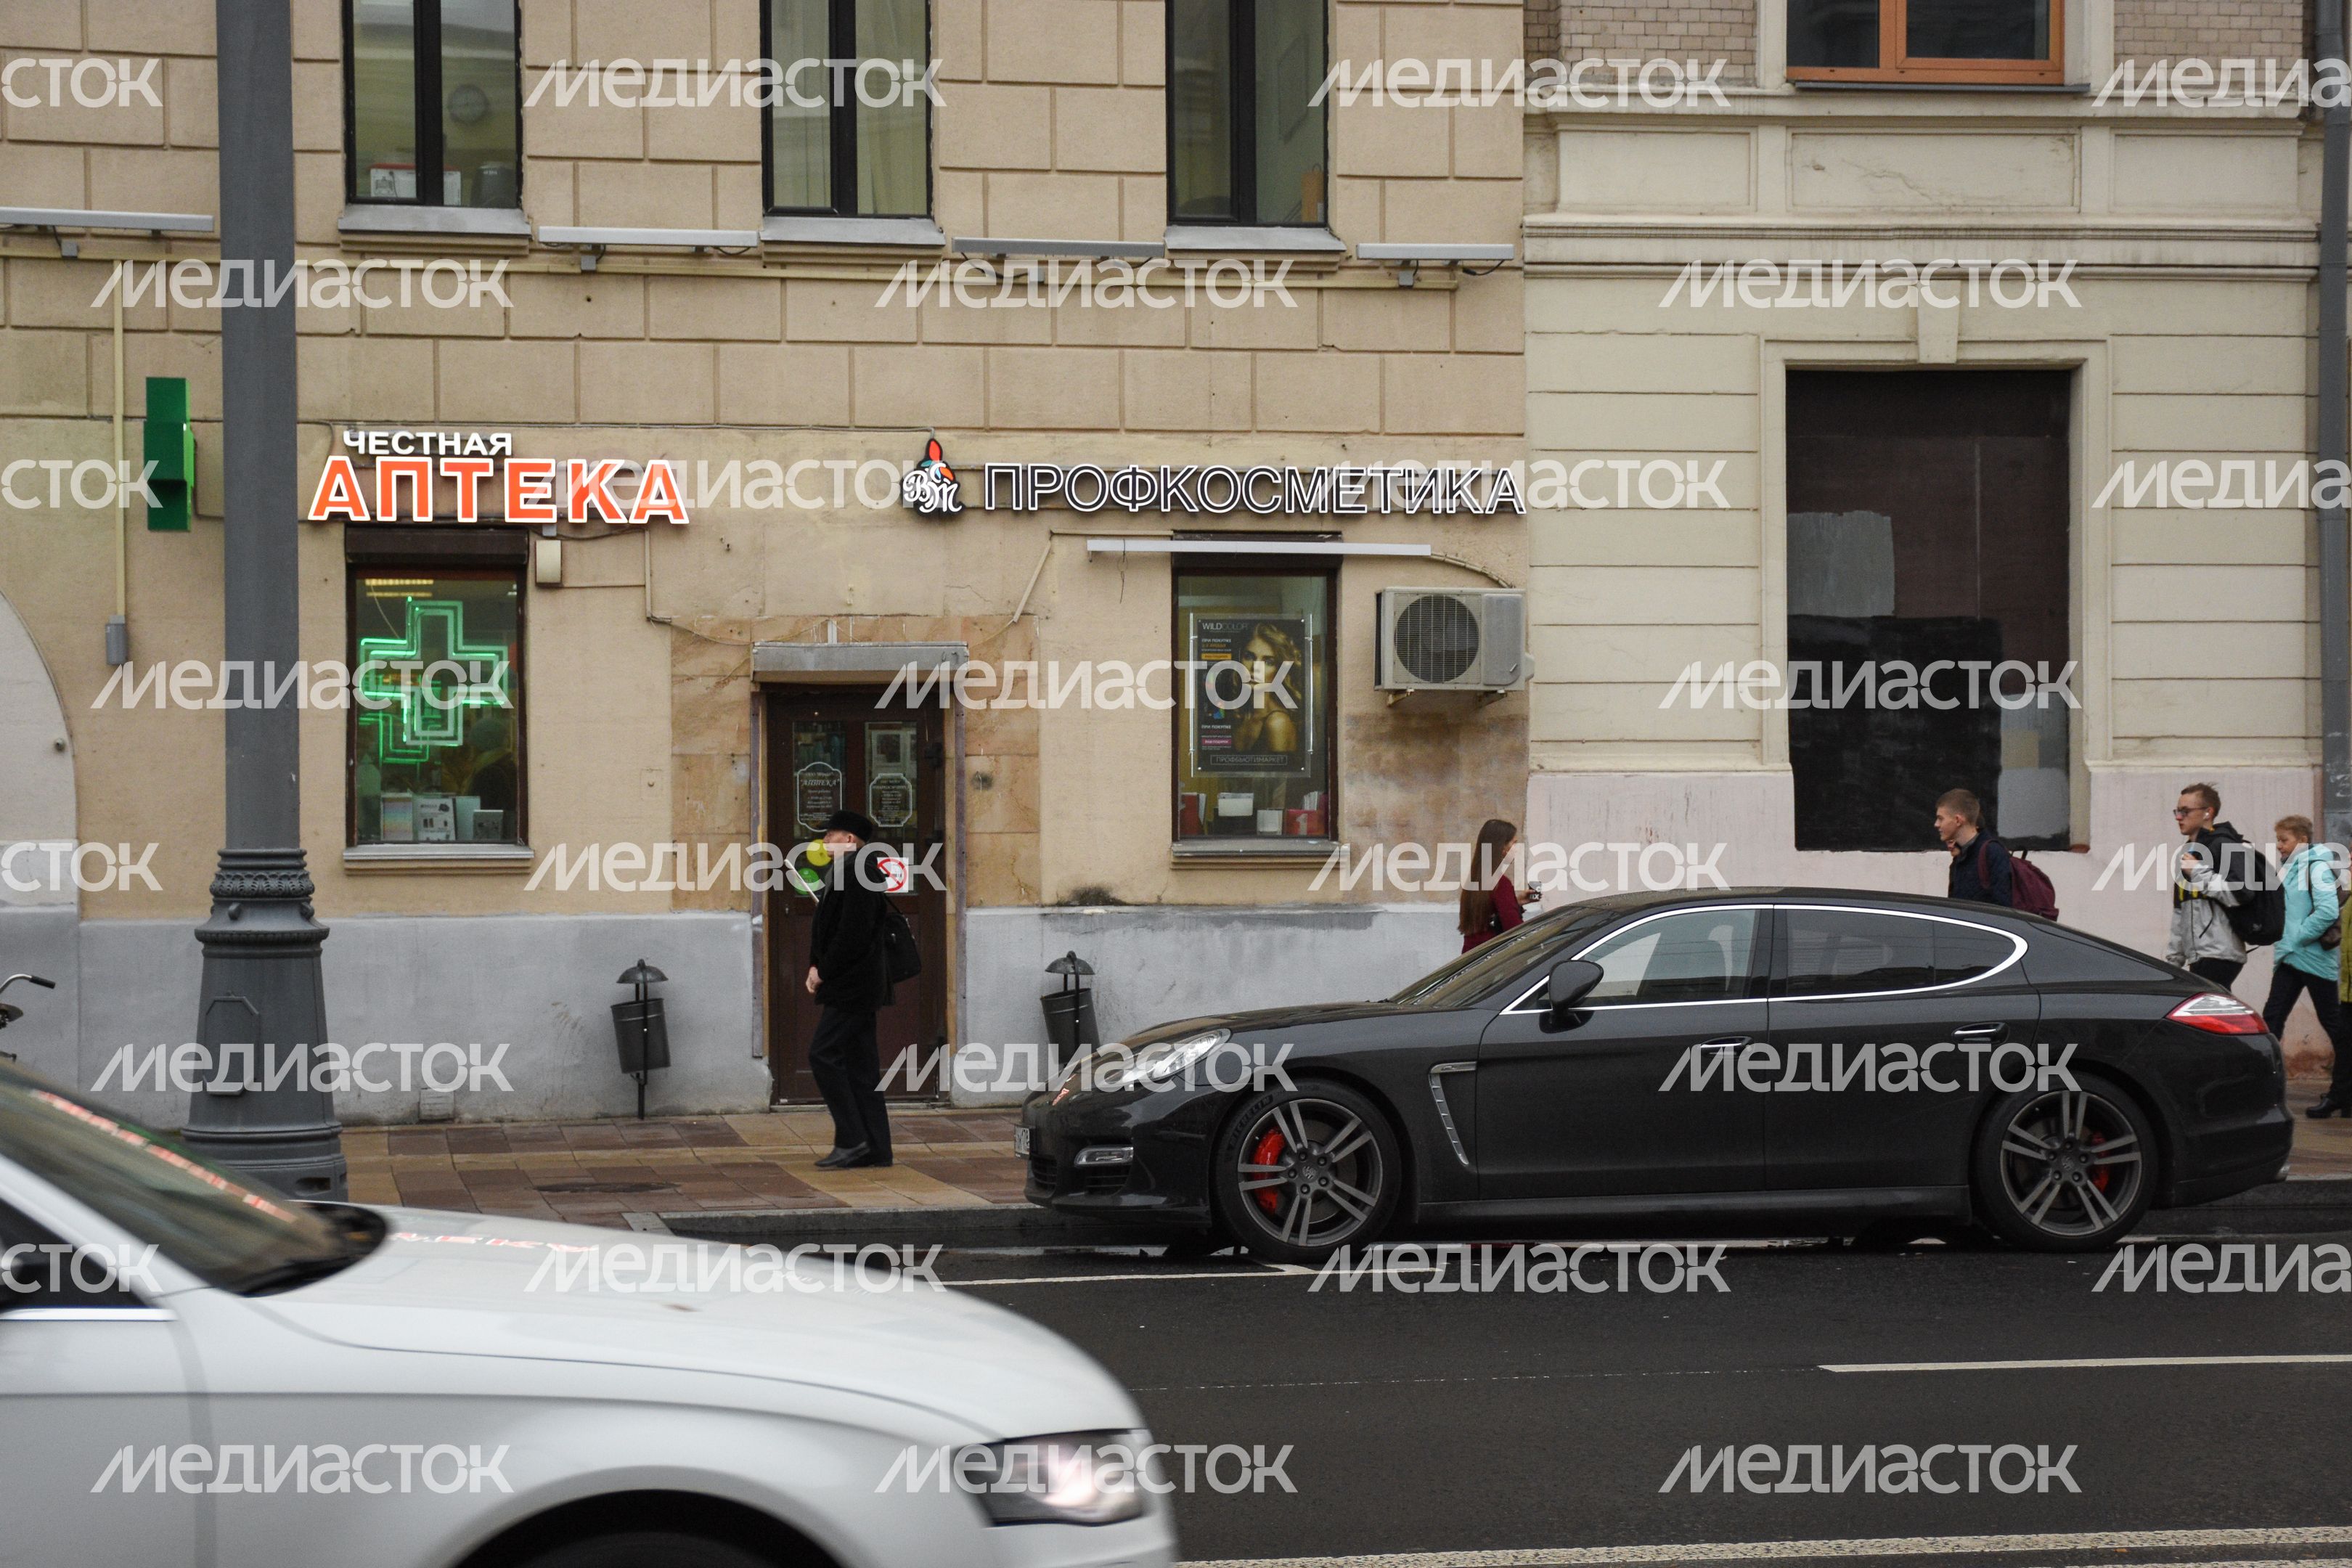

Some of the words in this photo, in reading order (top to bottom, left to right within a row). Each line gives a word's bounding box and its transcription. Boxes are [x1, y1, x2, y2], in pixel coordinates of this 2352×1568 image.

[343, 430, 513, 456] ЧЕСТНАЯ
[308, 455, 690, 524] АПТЕКА
[984, 462, 1527, 515] ПРОФКОСМЕТИКА
